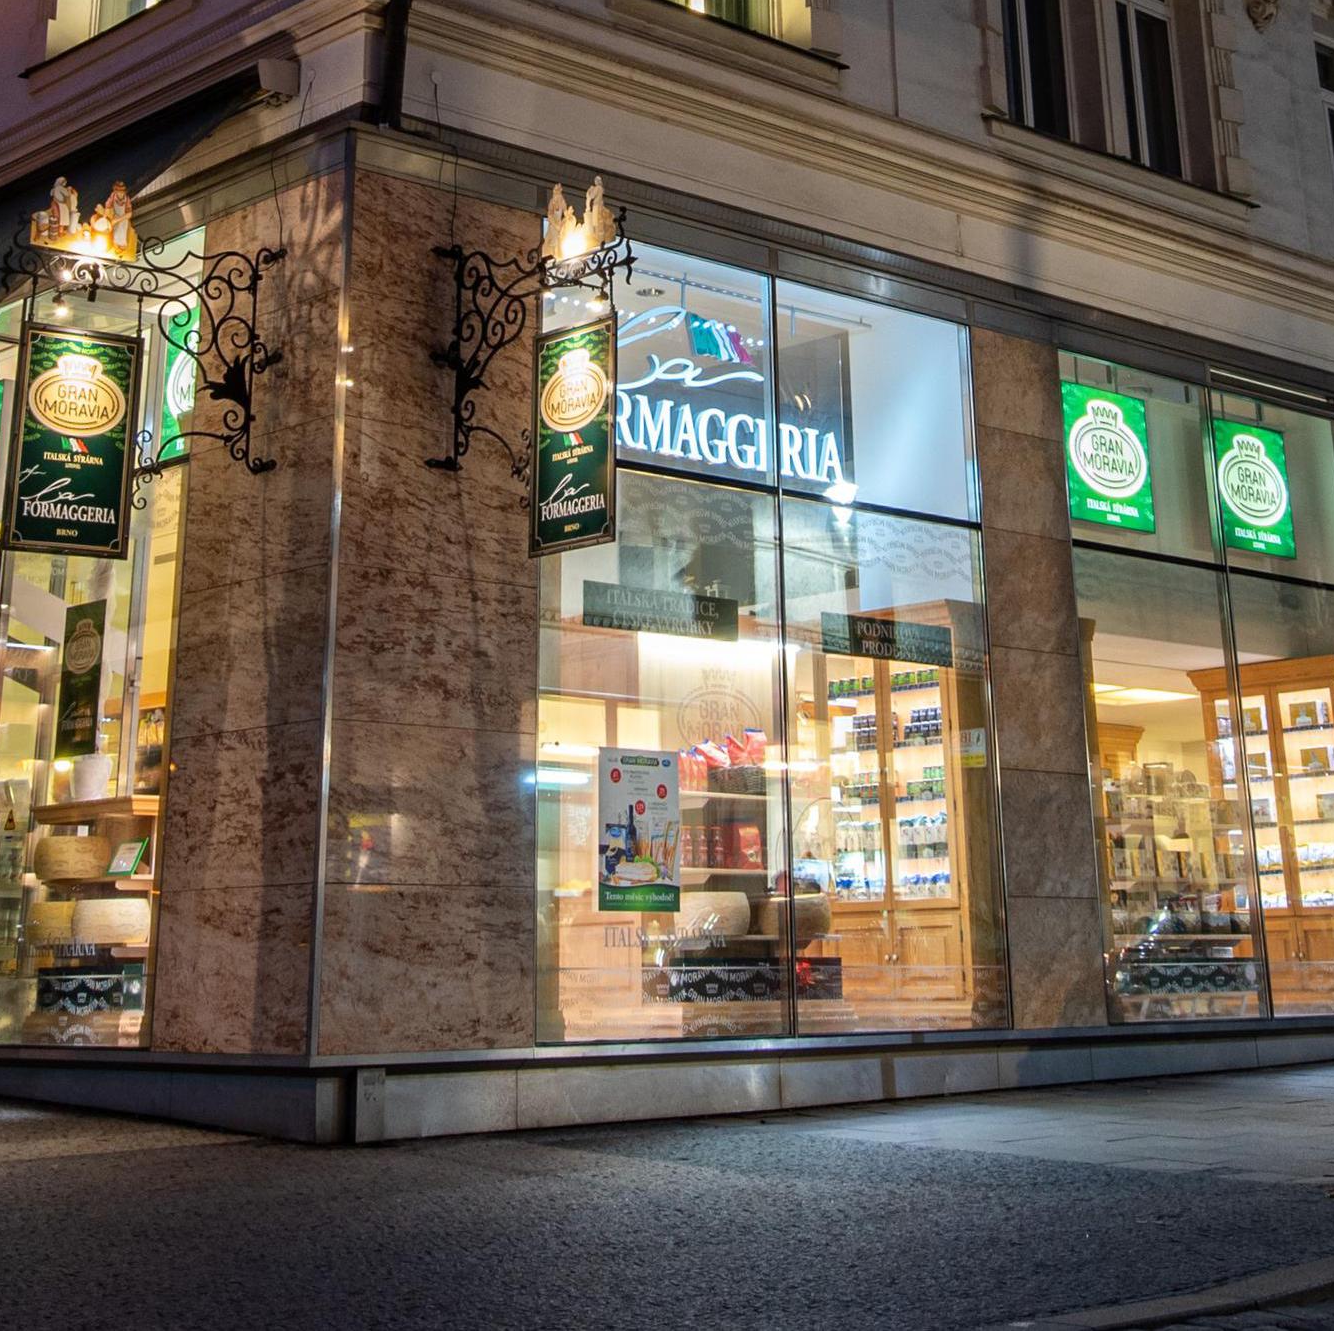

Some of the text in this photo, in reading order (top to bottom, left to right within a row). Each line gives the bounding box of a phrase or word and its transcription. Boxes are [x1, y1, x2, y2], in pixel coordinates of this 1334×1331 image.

[58, 384, 98, 402] GRAN
[559, 380, 587, 398] GRAN
[43, 399, 109, 420] MORAVIA
[551, 392, 597, 416] MORAVIA
[616, 390, 845, 484] RMAGGRIA
[1091, 434, 1123, 456] GRAN
[44, 451, 104, 466] ITALSKÁ SÝRÁRNA
[1083, 451, 1135, 476] MORAVIA
[1237, 466, 1266, 488] GRAN
[1231, 483, 1277, 506] MORAVIA
[23, 500, 116, 524] FORMAGGERIA
[541, 494, 605, 521] FORMAGGERIA
[57, 529, 78, 537] BRNO
[607, 588, 719, 619] ITALSKÁ TRADICE,
[655, 616, 715, 636] VÝROBKY
[857, 621, 920, 640] PODNIOV
[862, 640, 917, 661] PRODN
[699, 699, 740, 721] GRAN
[605, 891, 624, 901] Tento
[603, 926, 663, 948] ITALS
